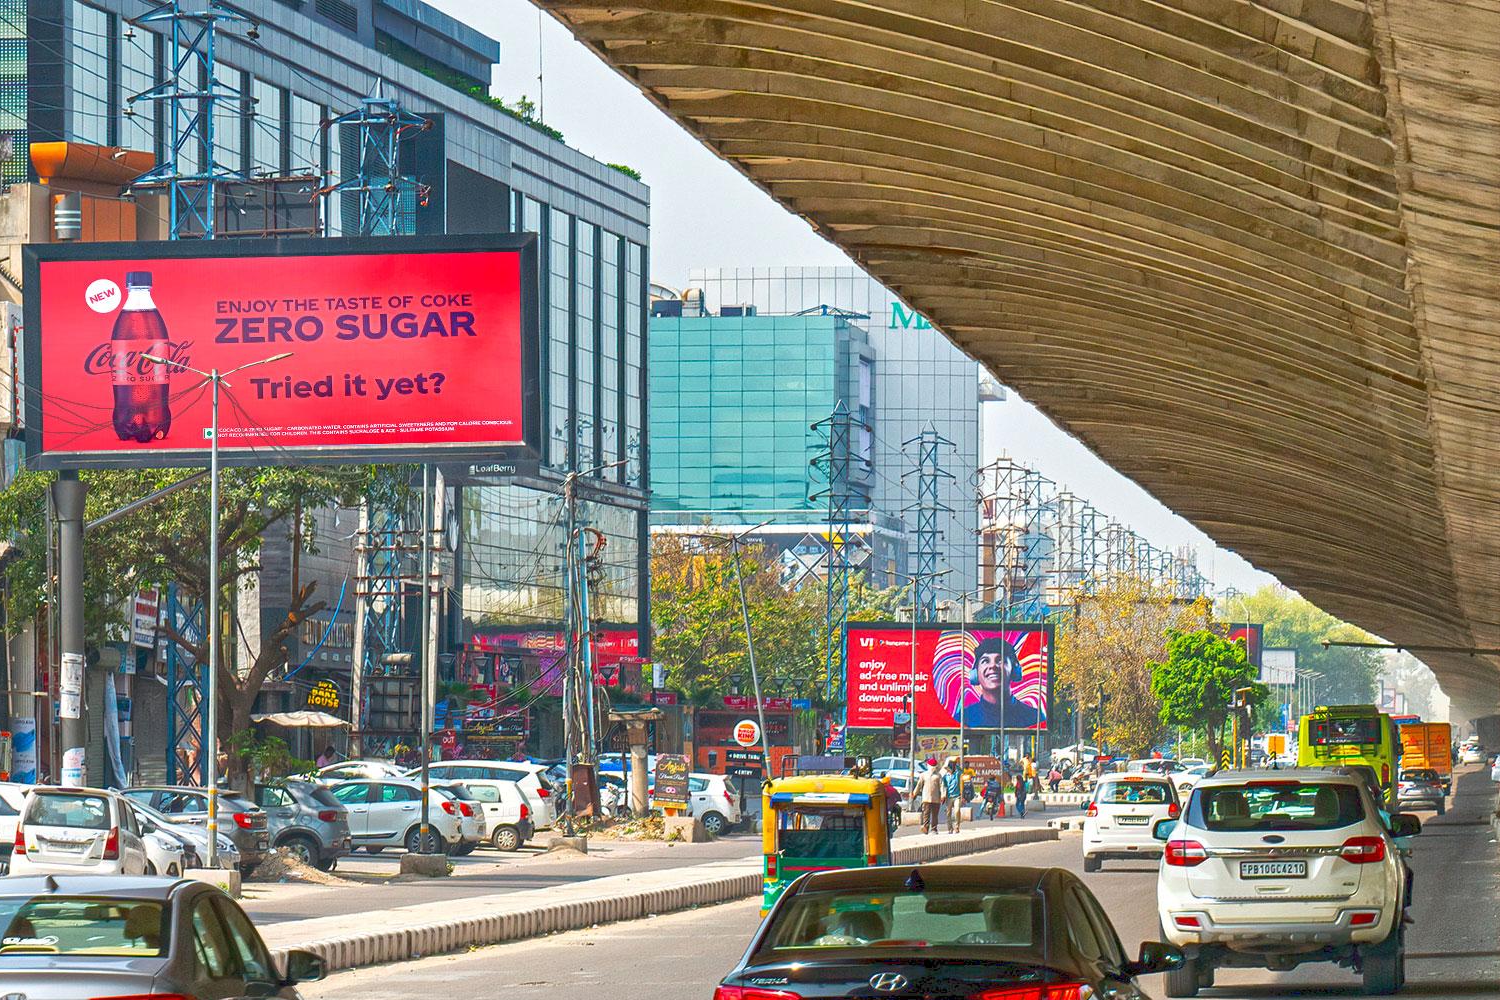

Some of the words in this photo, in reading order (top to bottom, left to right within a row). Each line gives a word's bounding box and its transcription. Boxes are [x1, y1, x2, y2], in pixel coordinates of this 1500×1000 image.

[89, 287, 115, 304] NEW
[216, 299, 277, 314] ENJOY
[283, 298, 319, 312] THE
[324, 297, 383, 311] TASTE
[388, 295, 413, 309] OF
[420, 293, 473, 308] COKE
[214, 316, 324, 344] ZERO
[335, 311, 478, 341] SUGAR
[250, 375, 333, 400] Tried
[344, 373, 366, 397] it
[375, 372, 446, 401] yet?
[859, 659, 887, 671] enjoy
[859, 671, 897, 680] ad-free
[899, 671, 929, 681] music
[859, 682, 878, 691] and
[307, 695, 340, 708] HOUSE
[858, 693, 913, 703] downloas
